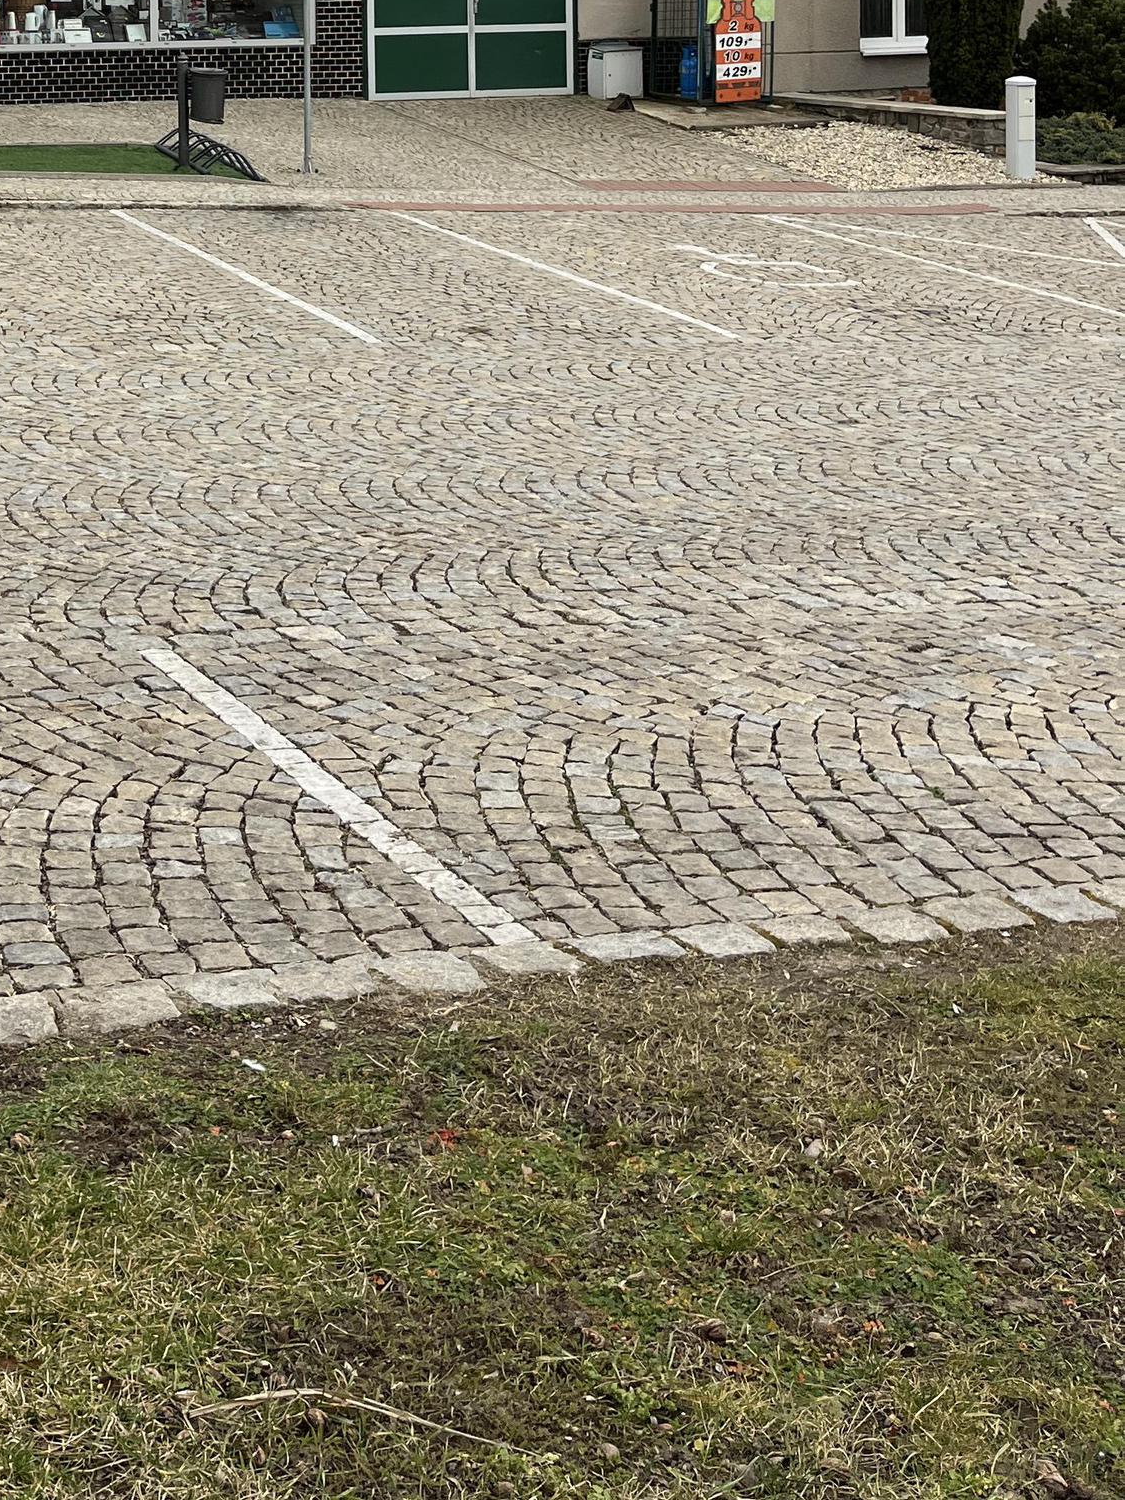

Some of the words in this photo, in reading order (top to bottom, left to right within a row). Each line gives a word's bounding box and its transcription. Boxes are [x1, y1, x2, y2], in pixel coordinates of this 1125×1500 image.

[728, 19, 738, 32] 2
[743, 22, 755, 32] kg
[719, 35, 753, 48] 109,-
[724, 50, 741, 62] 10
[743, 52, 755, 62] kg
[723, 65, 757, 78] 429,-
